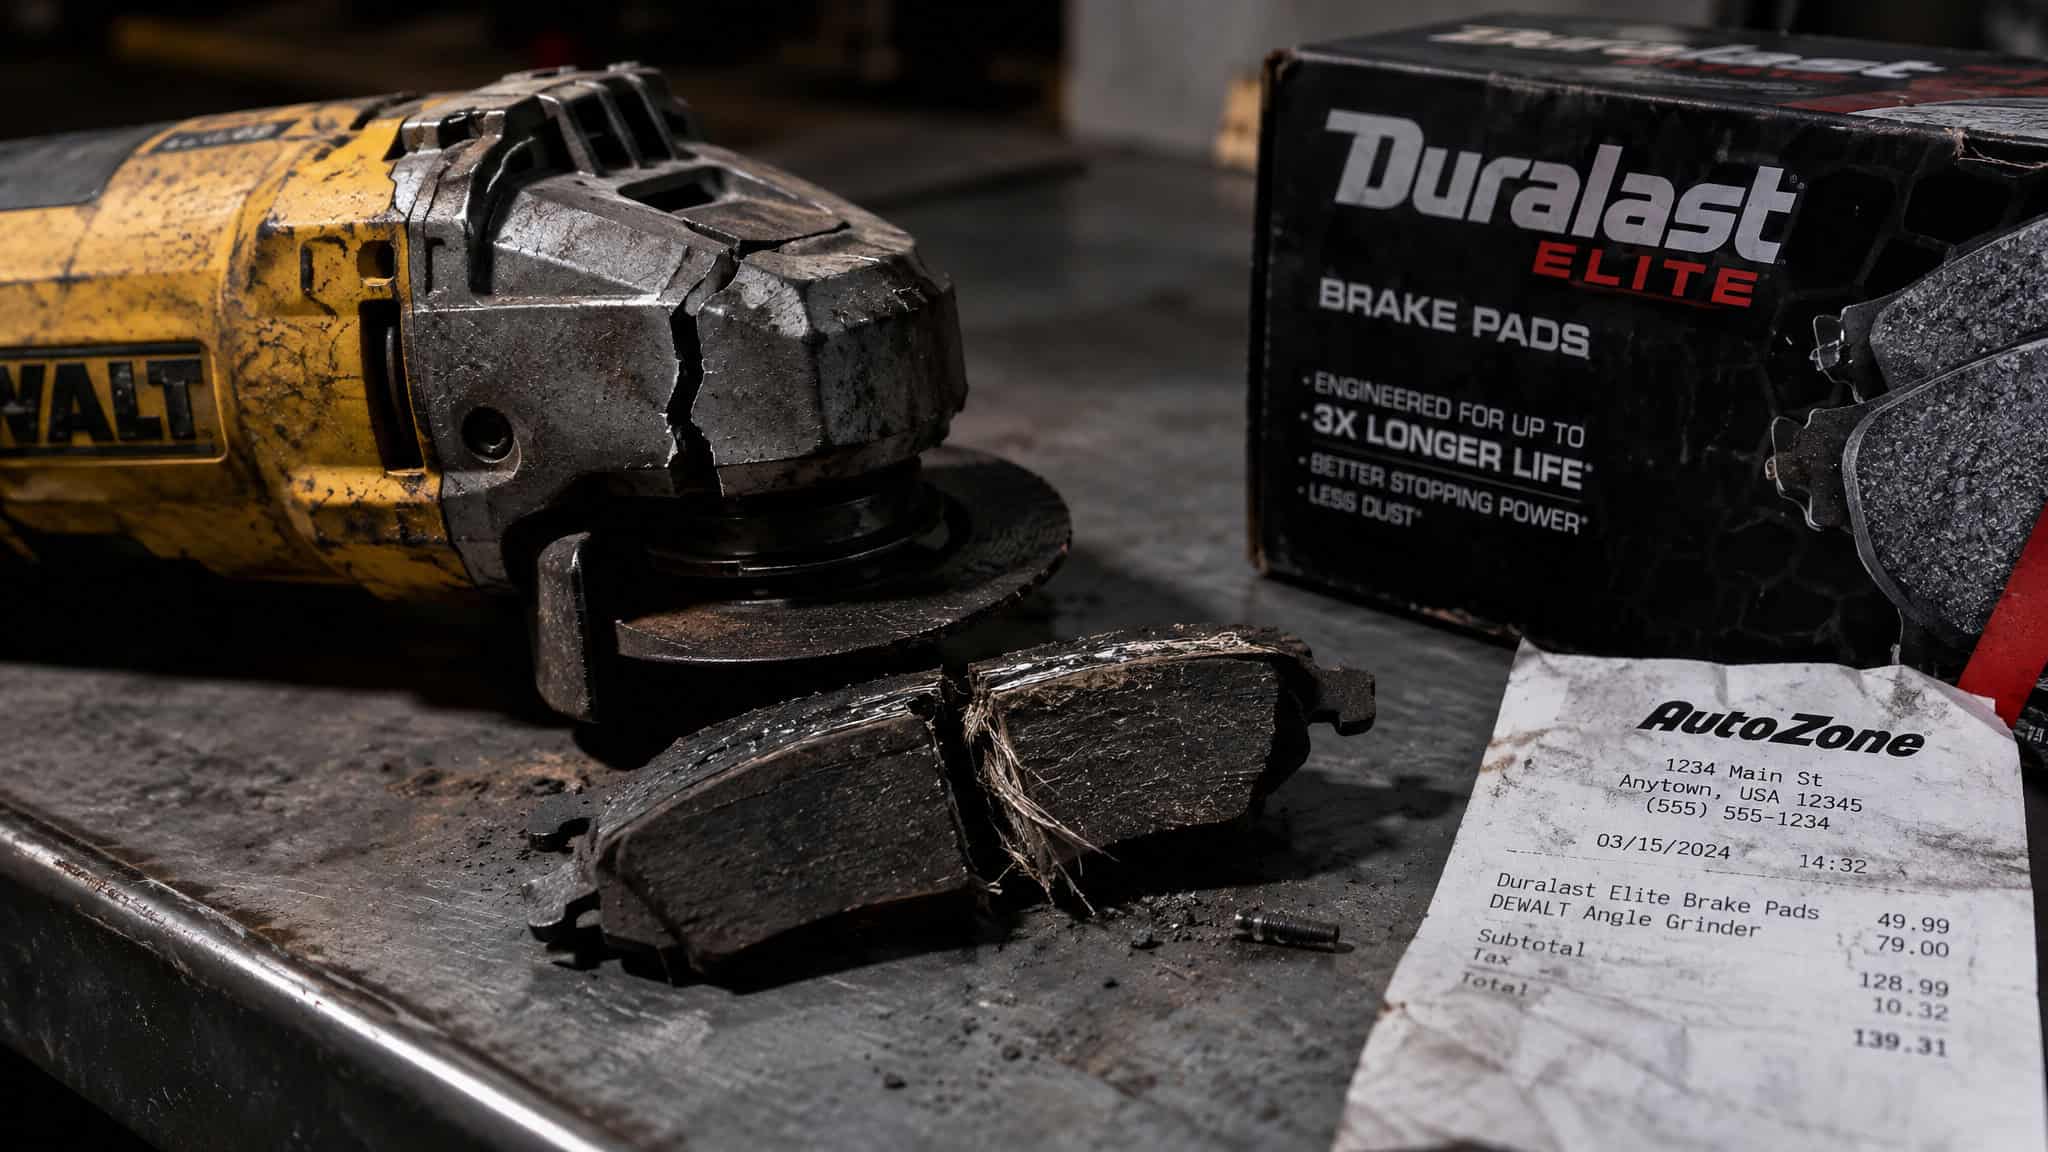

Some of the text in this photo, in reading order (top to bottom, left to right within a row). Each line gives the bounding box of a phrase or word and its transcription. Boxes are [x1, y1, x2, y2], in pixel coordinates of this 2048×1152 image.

[1325, 109, 1800, 264] Duralast
[1532, 240, 1758, 307] ELITE
[1319, 277, 1591, 360] BRAKE PADS
[1312, 403, 1358, 439] 3X
[1366, 414, 1502, 473] LONGER
[1314, 371, 1586, 449] ENGINEERED FOR UP TO
[1308, 481, 1357, 512] LESS
[1310, 451, 1385, 489] BETTER
[1389, 471, 1493, 514] STOPPING
[1636, 700, 1925, 757] AutoZone
[1619, 773, 1863, 813] Anytown, USA 12345
[1664, 757, 1823, 787] 1234 Main St
[1645, 796, 1831, 831] (555) 555-1234
[1596, 832, 1867, 875] 03/15/2024 14:32
[1490, 893, 1950, 958] DEWALT Angle Grinder 79.00
[1497, 872, 1950, 934] Duralast Elite Brake Pads 49.99
[1472, 947, 1949, 1023] Tax 10.32
[1477, 928, 1950, 998] Subtotal 128.99
[1460, 970, 1947, 1057] Total 139.31
